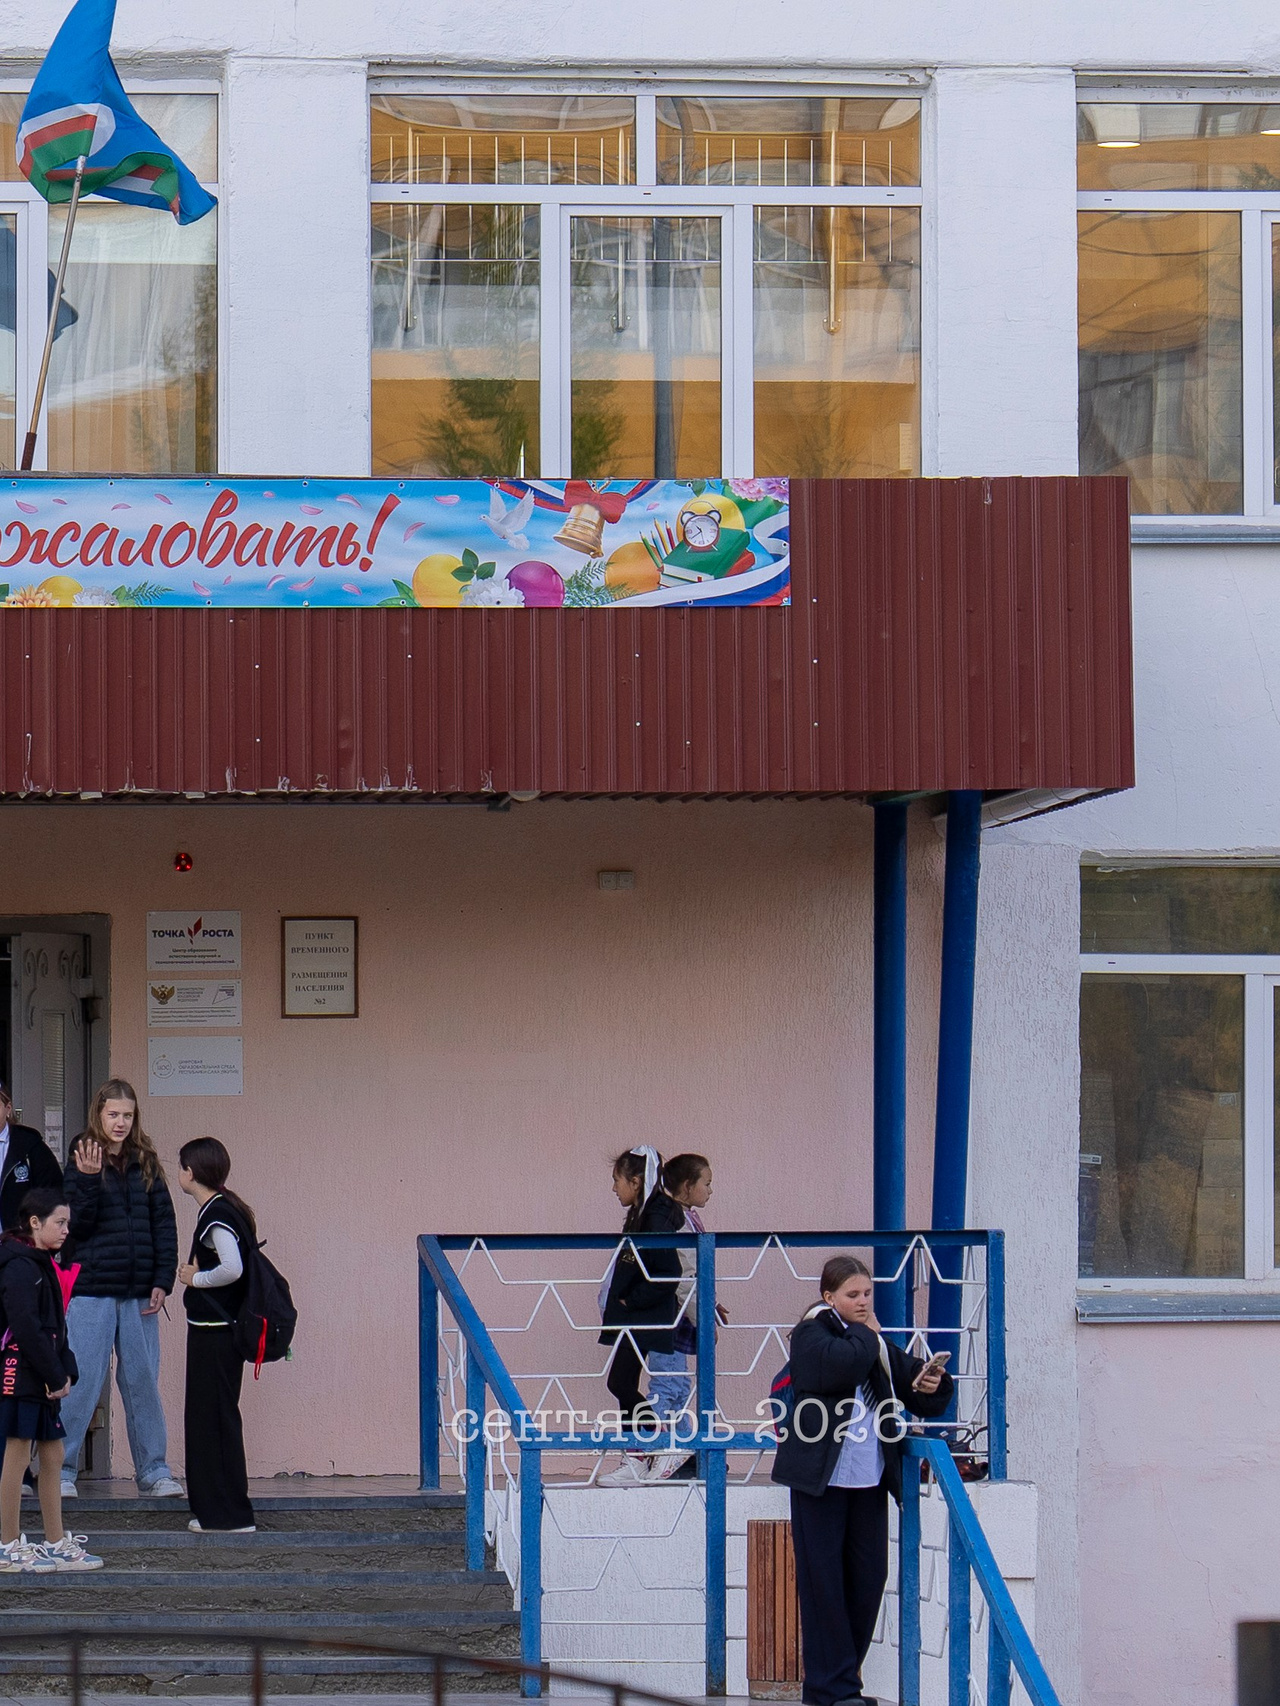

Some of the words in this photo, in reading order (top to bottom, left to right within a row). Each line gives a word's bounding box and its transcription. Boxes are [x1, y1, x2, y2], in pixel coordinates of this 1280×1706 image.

[152, 929, 186, 938] ТОЧКА
[202, 929, 235, 938] РОСТА
[305, 932, 334, 940] ПУНКТ
[291, 946, 350, 954] ВРЕМЕННОГО
[291, 971, 348, 979] РАЗМЕЩЕНИЯ
[295, 984, 345, 992] НАСЕЛЕНИЯ
